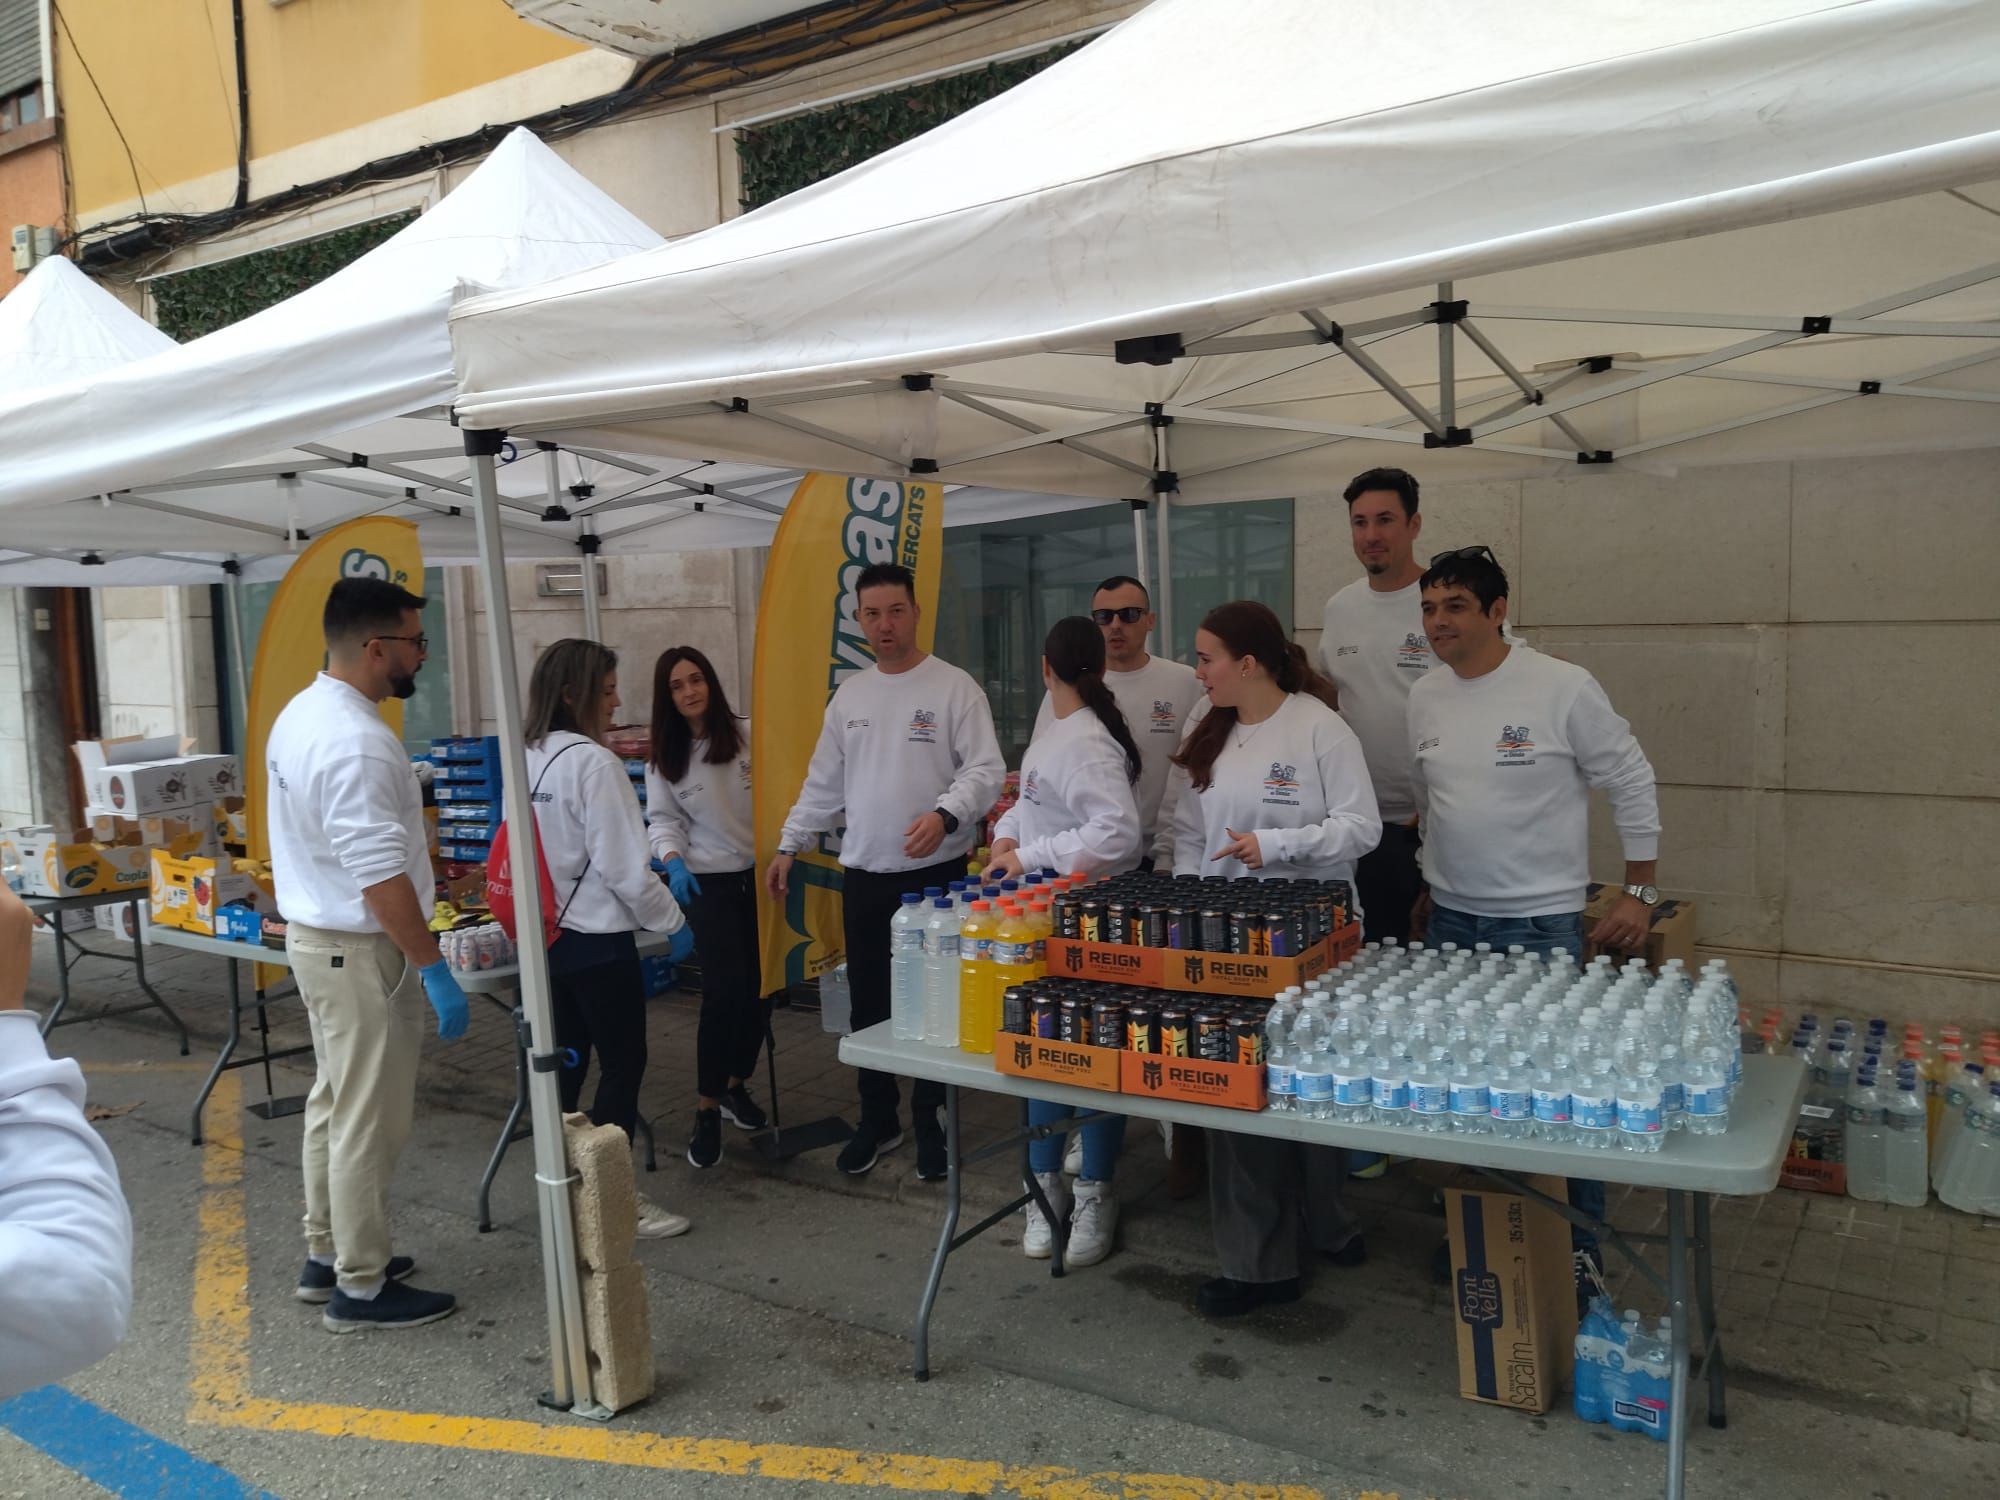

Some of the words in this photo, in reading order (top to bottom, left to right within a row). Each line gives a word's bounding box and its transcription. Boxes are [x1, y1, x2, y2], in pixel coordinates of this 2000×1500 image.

[902, 484, 926, 576] ERCATS
[1088, 951, 1141, 969] REIGN
[1210, 961, 1269, 978] REIGN
[1038, 1047, 1092, 1068] REIGN
[1169, 1067, 1229, 1087] REIGN
[1463, 1274, 1478, 1321] Font
[1480, 1276, 1499, 1323] Vella
[1507, 1341, 1538, 1407] Sacalm
